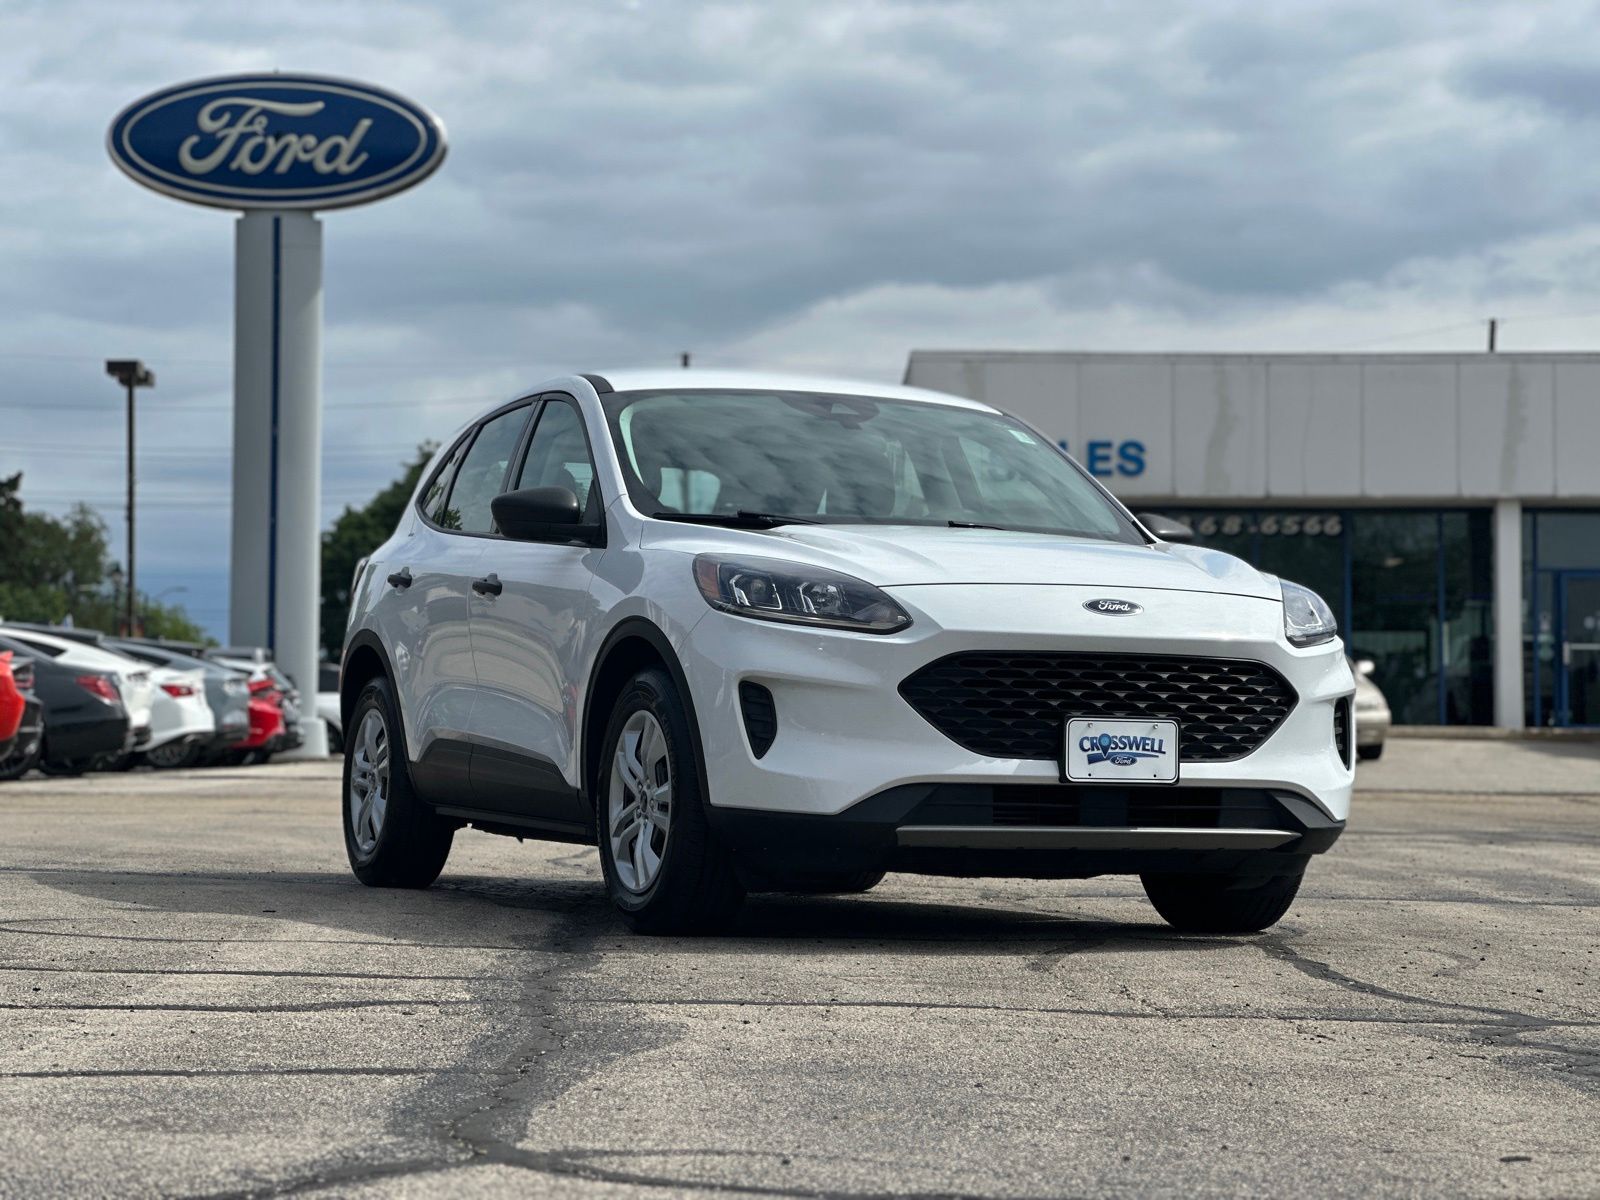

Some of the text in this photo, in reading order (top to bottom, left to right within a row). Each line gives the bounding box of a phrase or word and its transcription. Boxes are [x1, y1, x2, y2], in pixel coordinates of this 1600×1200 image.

[178, 96, 373, 174] Ford
[1058, 440, 1147, 477] ES
[1098, 600, 1131, 611] Ford
[1079, 733, 1166, 755] CROSSWELL
[1114, 756, 1132, 765] Ford
